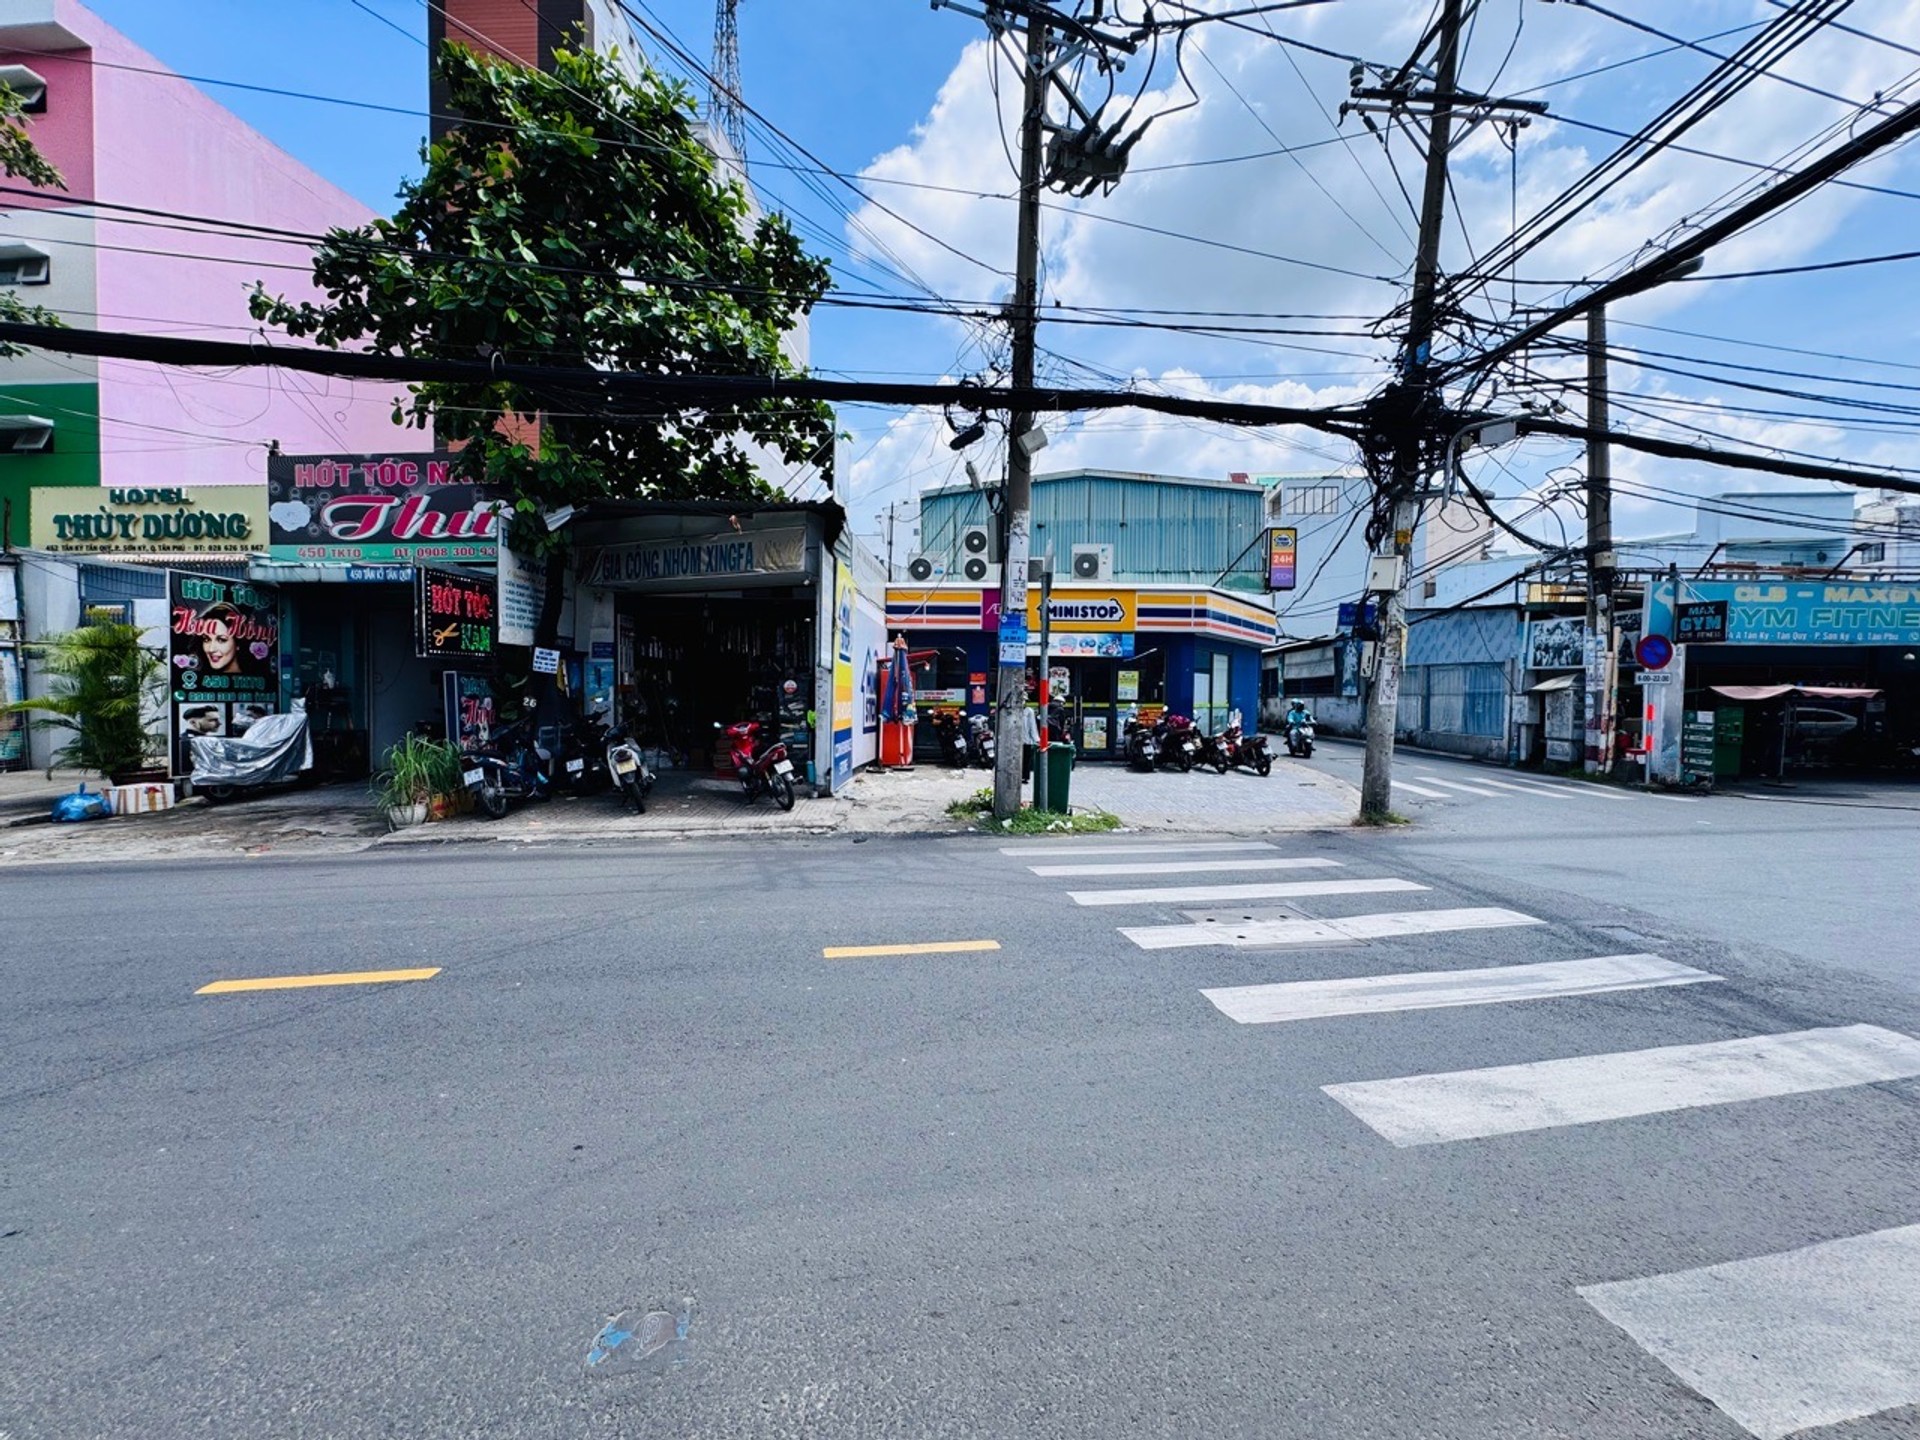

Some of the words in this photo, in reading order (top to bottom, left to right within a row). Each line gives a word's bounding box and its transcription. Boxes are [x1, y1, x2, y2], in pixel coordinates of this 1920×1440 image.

[295, 458, 352, 487] HỚT
[361, 458, 418, 487] TÓC
[109, 488, 195, 505] HOTEL
[53, 505, 140, 541] THÙY
[143, 507, 252, 541] DƯƠNG
[297, 547, 326, 558] 450
[417, 547, 448, 558] 0908
[453, 547, 475, 557] 300
[602, 554, 621, 580] GIA
[626, 543, 660, 579] CÔNG
[663, 540, 702, 575] NHÔM
[705, 542, 753, 573] XINGFA
[1273, 555, 1293, 563] 24H
[464, 585, 490, 620] TÓC
[1734, 586, 1787, 602] CLB
[1046, 605, 1119, 618] MINISTOP
[1687, 605, 1716, 616] MAX
[1809, 607, 1920, 628] FITNE
[1680, 615, 1722, 632] GYM
[461, 623, 491, 652] NAM
[522, 696, 537, 708] 26
